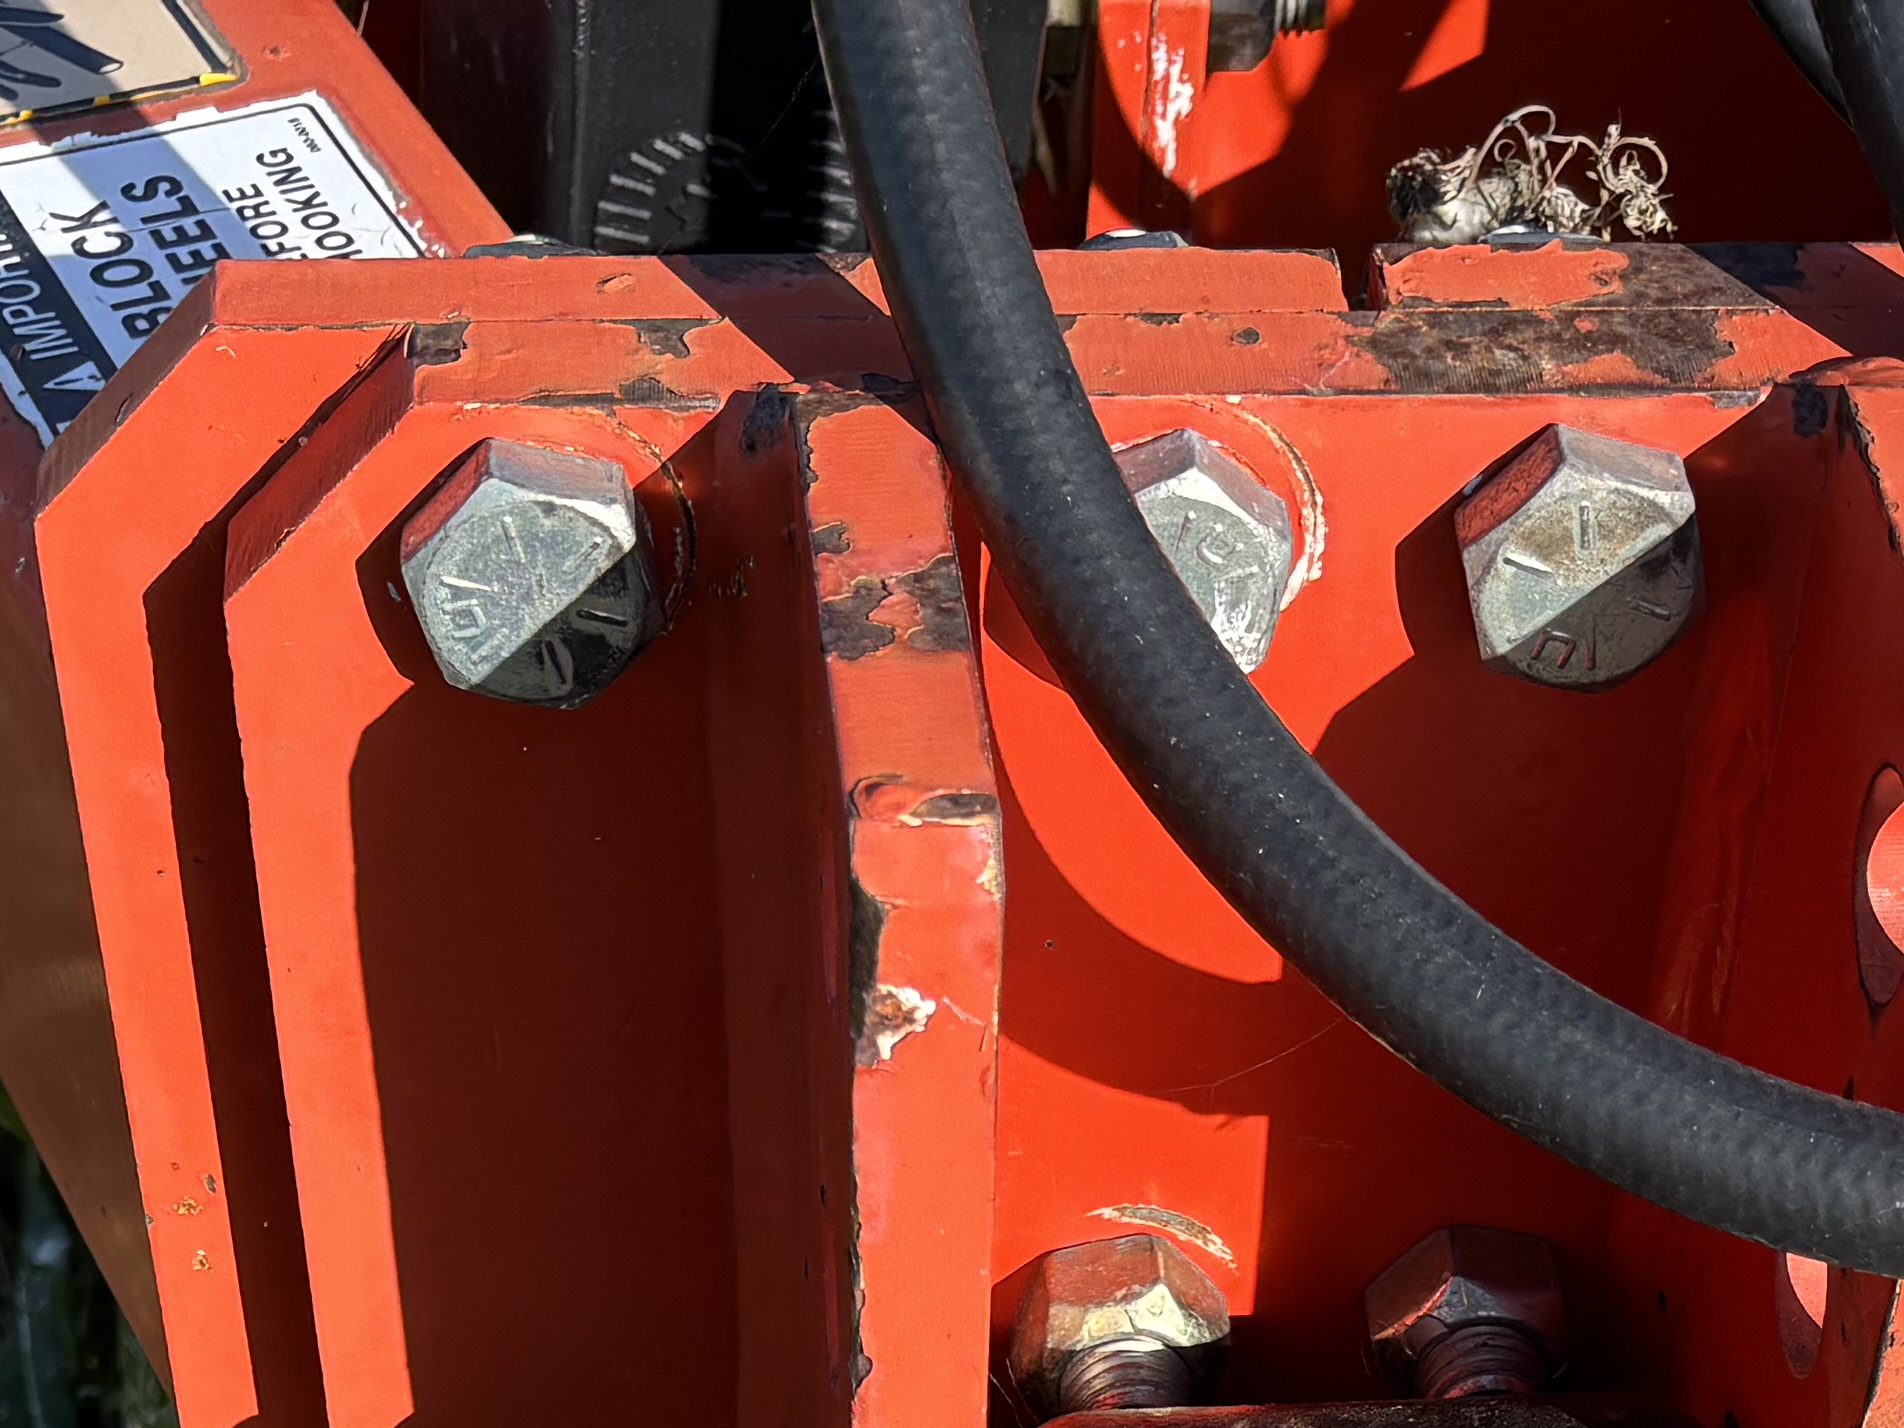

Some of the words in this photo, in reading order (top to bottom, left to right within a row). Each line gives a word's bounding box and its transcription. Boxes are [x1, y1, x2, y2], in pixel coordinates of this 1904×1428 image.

[48, 201, 172, 339] BLOCK
[121, 174, 228, 286] EELS
[222, 183, 309, 258] FORE
